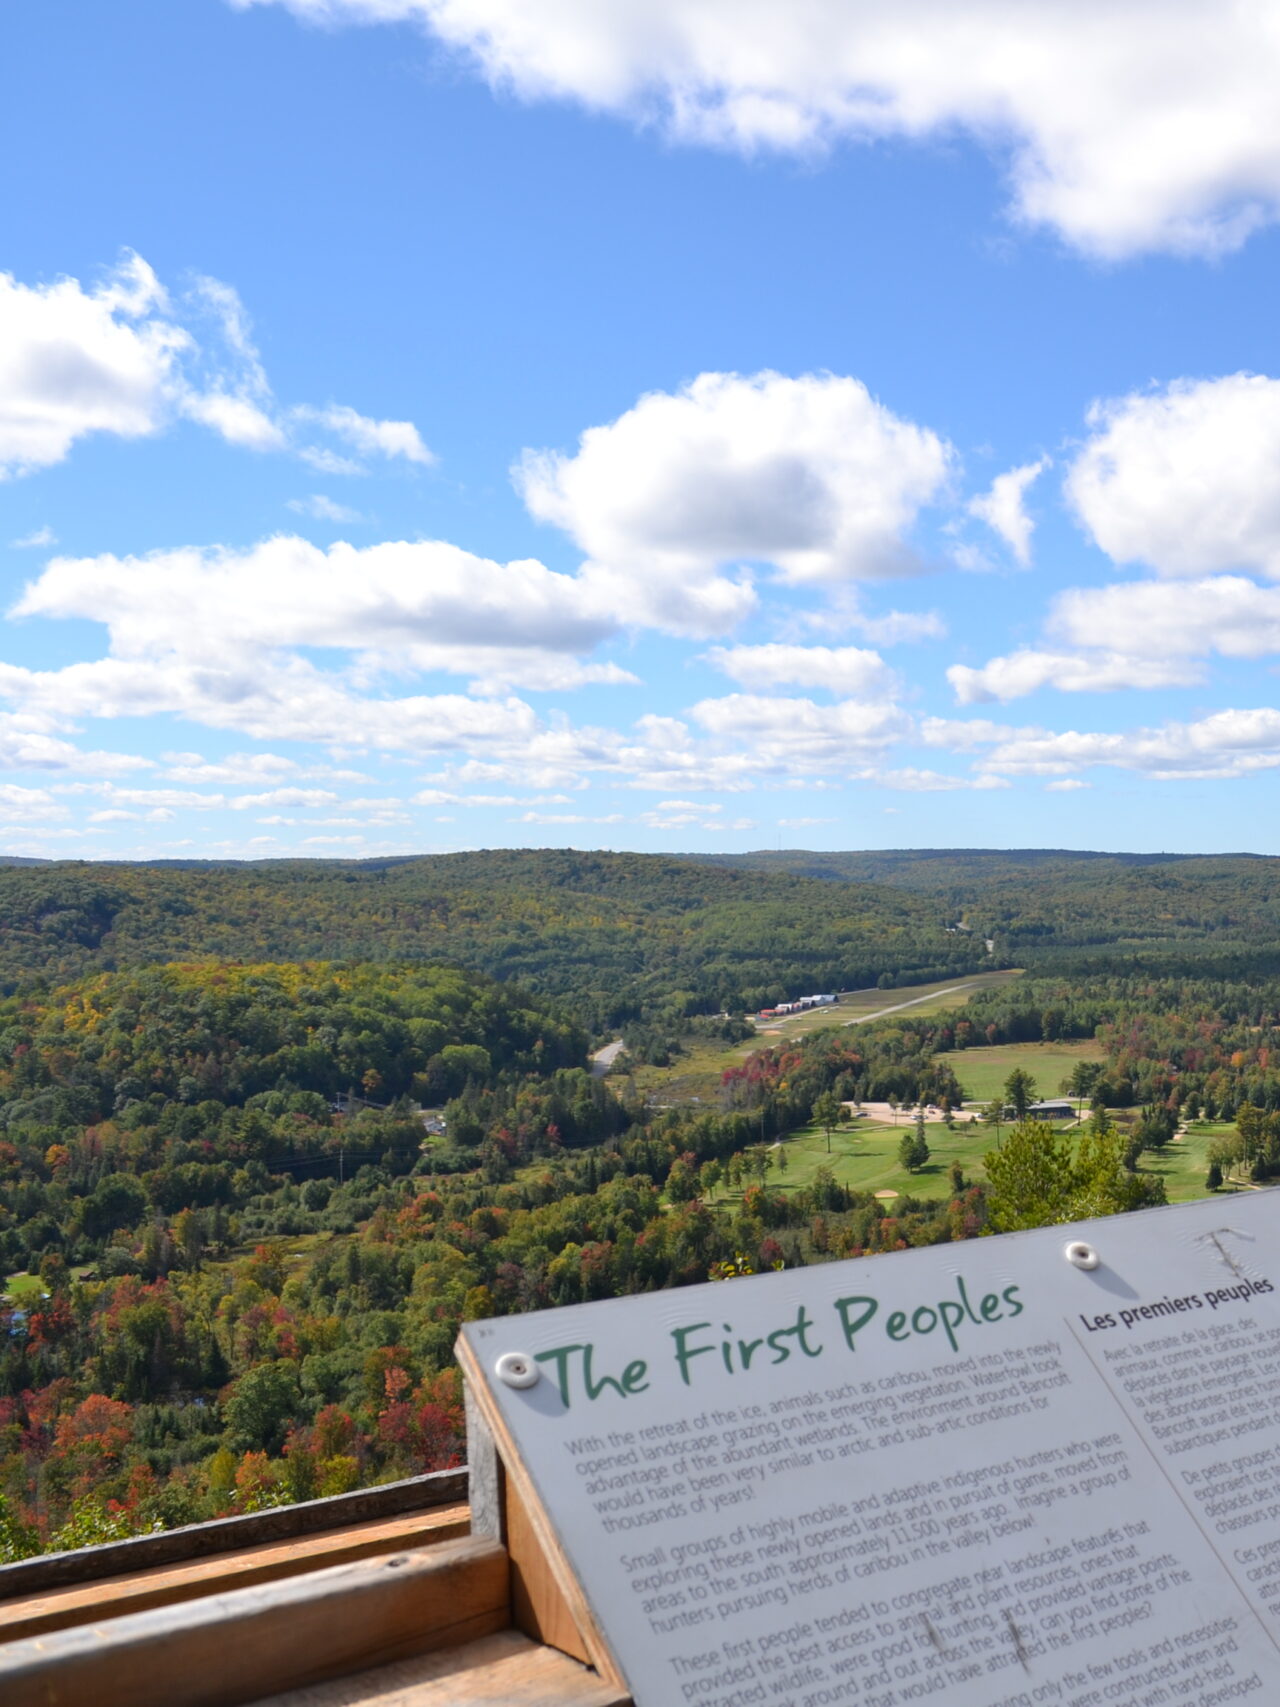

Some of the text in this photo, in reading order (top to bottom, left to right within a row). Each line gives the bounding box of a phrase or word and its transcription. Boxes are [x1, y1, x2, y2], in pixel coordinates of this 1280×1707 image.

[533, 1275, 1025, 1409] The First Peoples
[1079, 1277, 1275, 1333] Les premiers peuples
[1103, 1347, 1131, 1361] Avec
[1142, 1336, 1181, 1352] retraite
[1238, 1318, 1258, 1330] des
[1162, 1348, 1202, 1365] comme
[564, 1340, 1062, 1456] With the retreat of the ice, animals such as caribou, moved into the newly
[575, 1357, 1062, 1477] opened landscape grazing on the emerging vegetation. Waterfowl took
[585, 1372, 1072, 1495] advantage of the abundant wetlands. The environment around Bancroft
[593, 1396, 1049, 1514] would have been very similar to arctic and sub-artic conditions for
[601, 1484, 754, 1534] thousands of years!
[619, 1434, 1122, 1573] Small groups of highly mobile and adaptive indigenous hunters who were
[631, 1450, 1128, 1593] exploring these newly opened lands and in pursuit of game, moved from
[642, 1466, 1132, 1614] areas to the south approximately 11,500 years ago. Imagine a group of
[648, 1513, 1035, 1634] hunters pursuing herds of caribou in the valley below!
